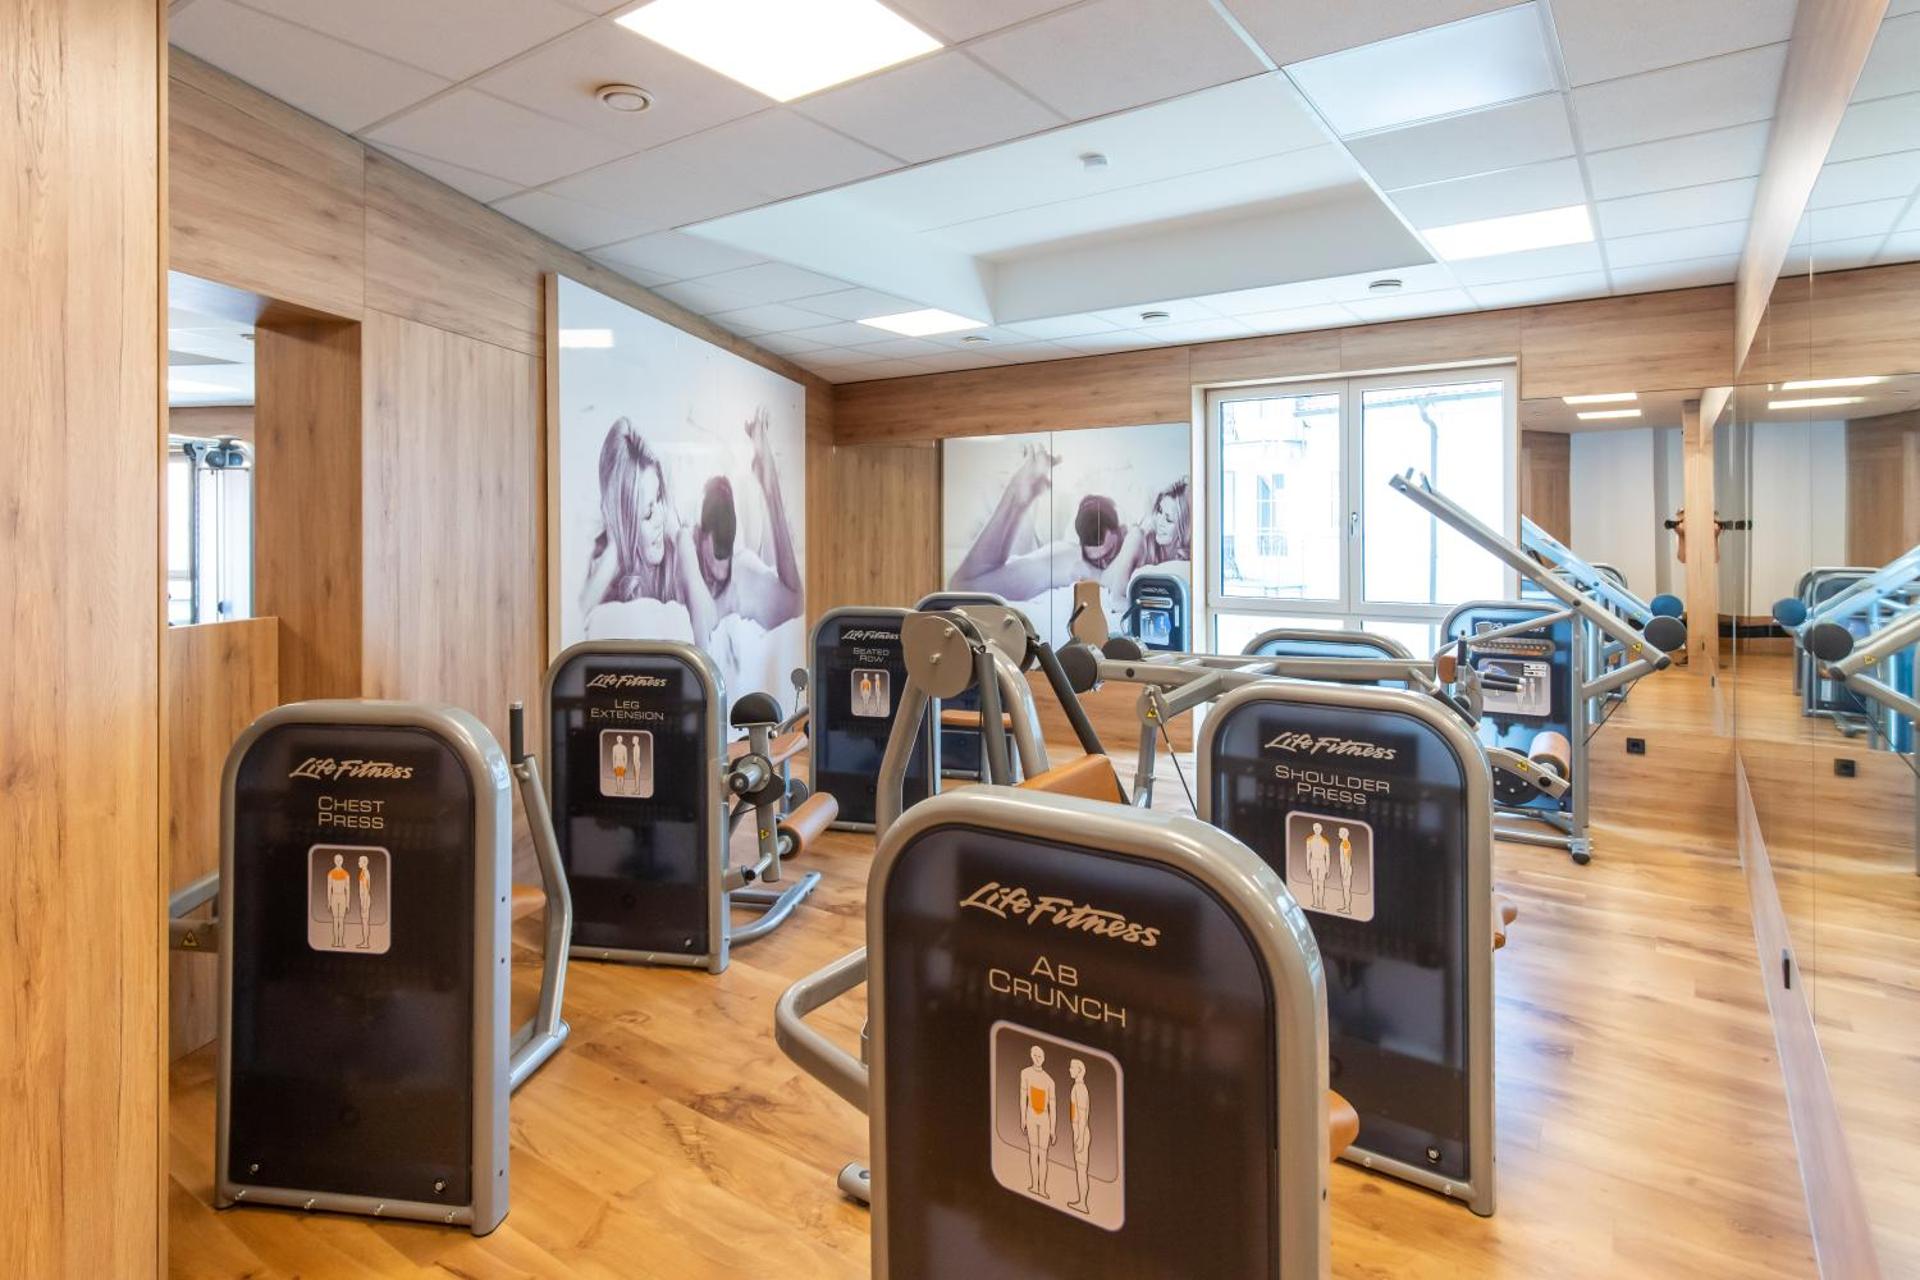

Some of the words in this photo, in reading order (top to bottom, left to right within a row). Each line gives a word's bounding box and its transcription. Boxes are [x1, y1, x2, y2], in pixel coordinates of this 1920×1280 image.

[841, 629, 864, 640] Life
[586, 673, 618, 688] Life
[615, 674, 668, 689] Fitness
[590, 707, 664, 720] EXTENSION
[614, 698, 640, 710] LEG
[1264, 731, 1313, 753] Life
[1310, 737, 1397, 760] Fitness
[288, 757, 337, 780] Life
[332, 760, 414, 781] Fitness
[1275, 764, 1390, 794] SHOULDER
[318, 796, 385, 813] CHEST
[1297, 782, 1367, 805] PRESS
[318, 812, 384, 829] PRESS
[959, 881, 1032, 919] Life
[1027, 896, 1161, 947] Fitness
[1030, 956, 1079, 987] AB
[988, 968, 1127, 1028] CRUNCH
